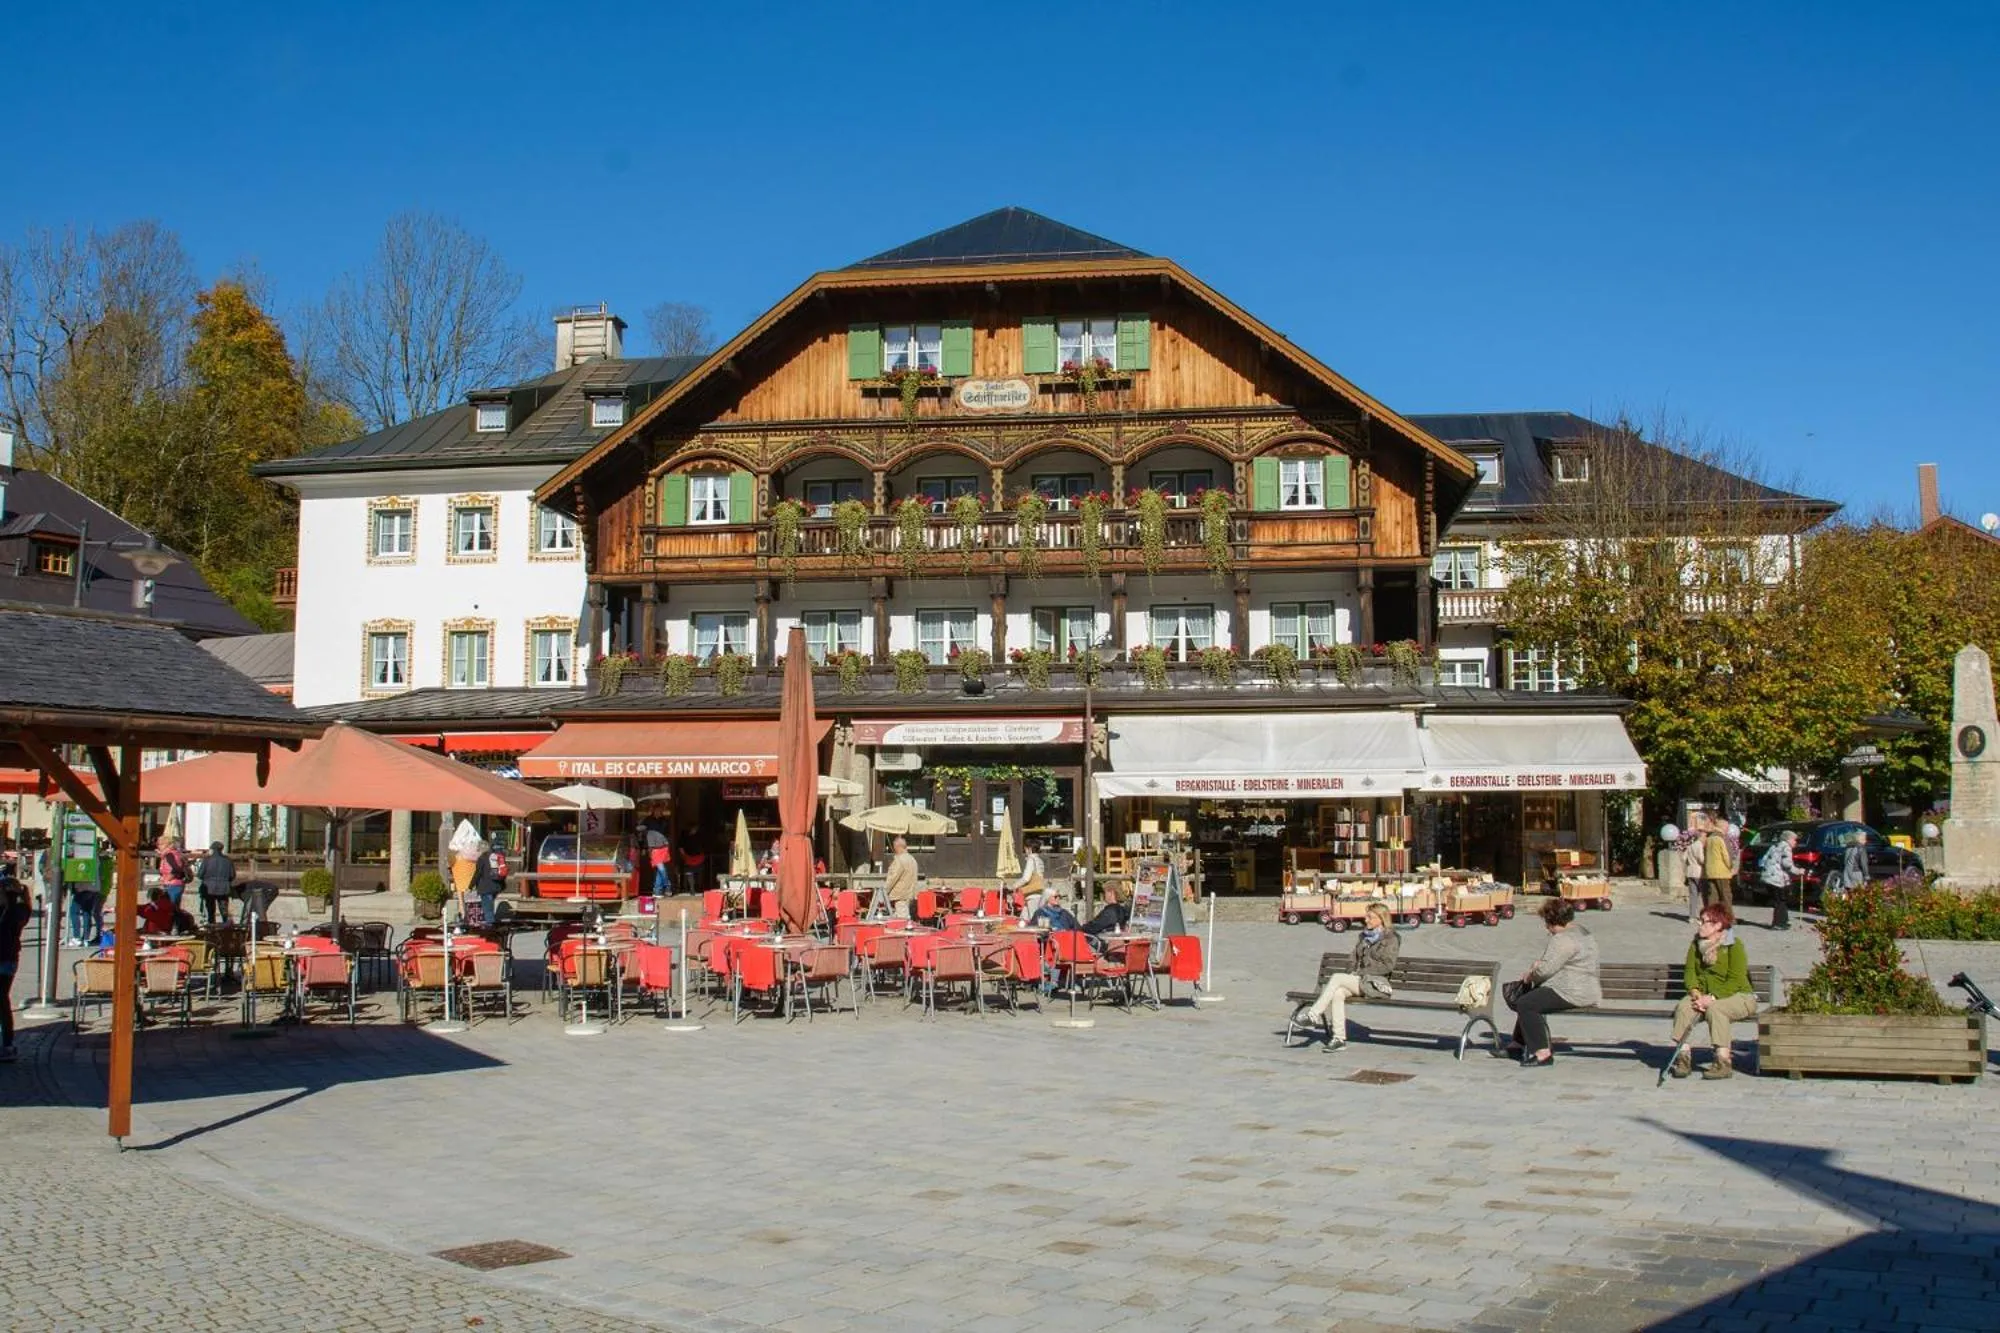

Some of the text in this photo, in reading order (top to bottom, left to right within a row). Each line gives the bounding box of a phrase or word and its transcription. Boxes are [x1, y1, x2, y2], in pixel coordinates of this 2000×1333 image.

[626, 761, 663, 775] CAFE
[667, 761, 694, 775] SAN
[699, 761, 751, 775] MARCO
[1175, 778, 1344, 791] BERGKRISTALLE EDELSTEINE MINERALIEN
[1450, 773, 1616, 787] BERGKRISTALLE EDELSTEINE MINERALIEN
